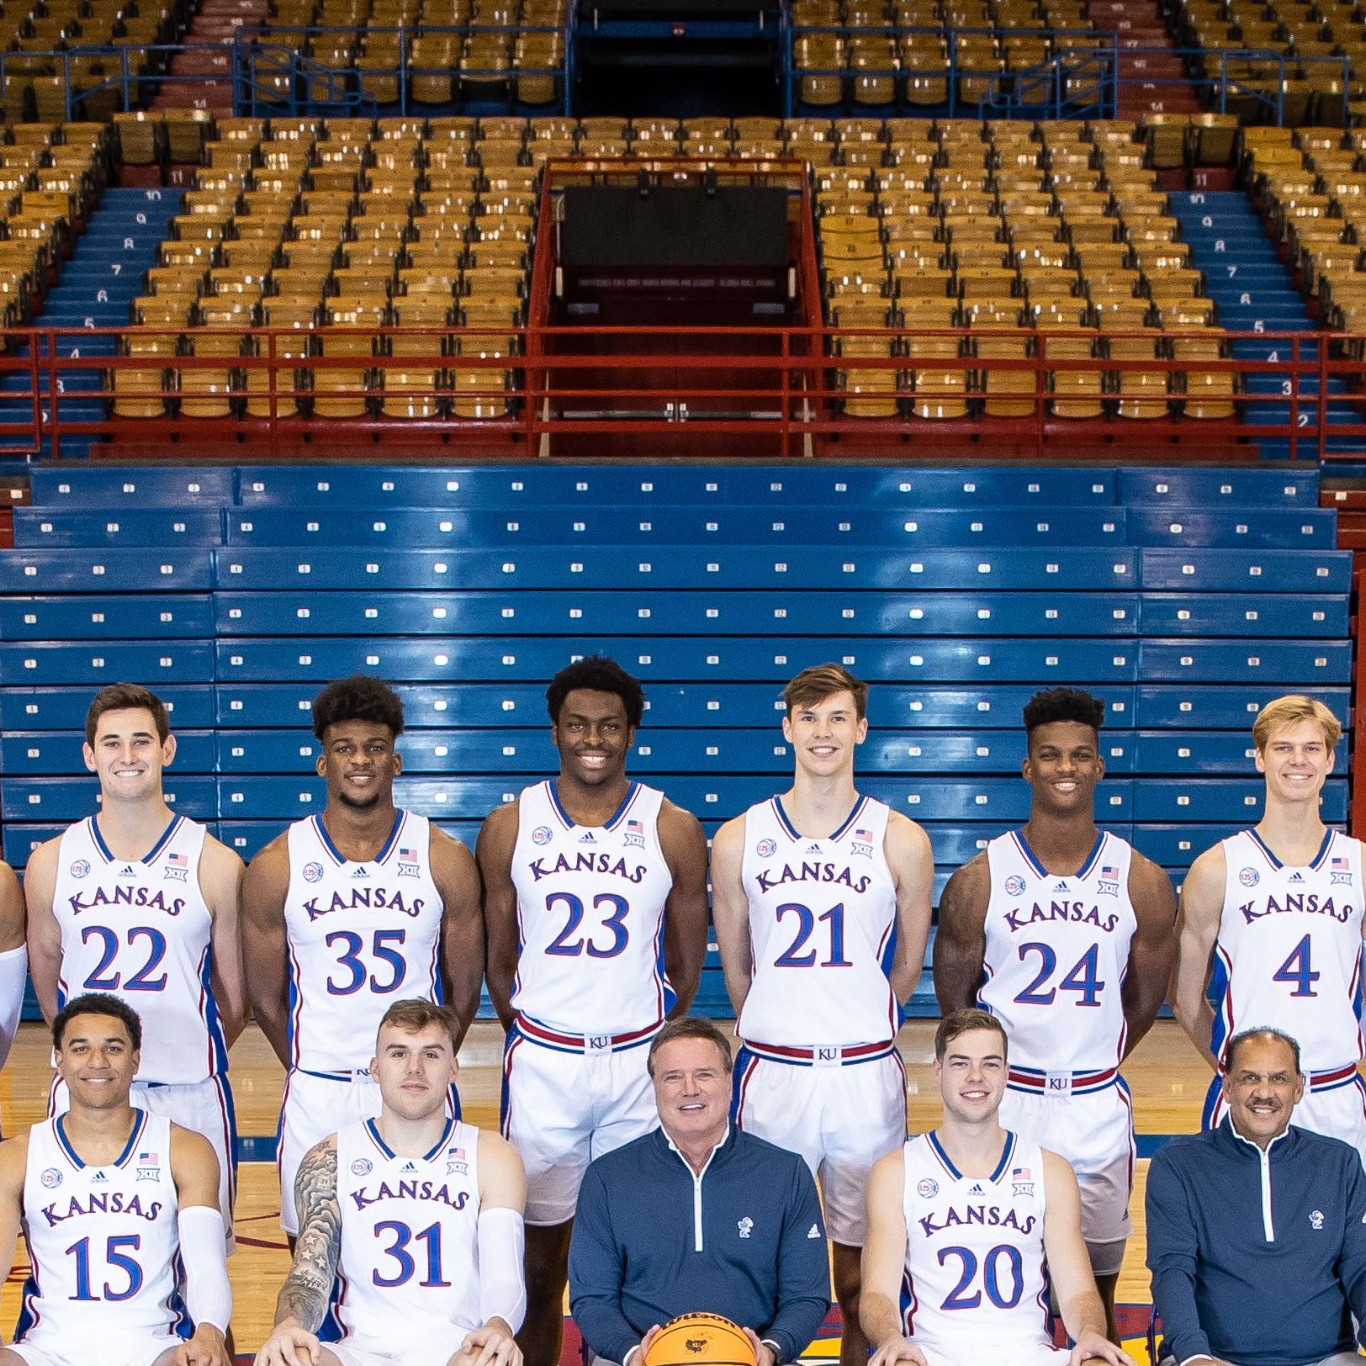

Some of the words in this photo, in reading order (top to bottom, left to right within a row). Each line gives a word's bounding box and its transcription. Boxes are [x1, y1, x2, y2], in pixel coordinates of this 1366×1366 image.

[171, 171, 183, 183] 11
[1196, 174, 1207, 186] 11
[146, 190, 162, 201] 10
[111, 264, 122, 276] 7
[1227, 266, 1237, 278] 7
[1254, 320, 1264, 333] 5
[1267, 351, 1279, 363] 4
[1282, 380, 1292, 395] 3
[1298, 414, 1308, 427] 2
[528, 852, 647, 884] KANSAS
[755, 861, 871, 894] KANSAS
[68, 885, 185, 916] KANSAS
[302, 888, 424, 922] KANSAS
[1239, 893, 1353, 924] KANSAS
[544, 891, 630, 959] 23
[1003, 900, 1119, 933] KANSAS
[773, 902, 853, 968] 21
[81, 925, 168, 991] 22
[325, 929, 407, 996] 35
[1272, 933, 1320, 997] 4
[1013, 942, 1105, 1007] 24
[590, 1037, 608, 1050] KU
[818, 1048, 837, 1061] KU
[1049, 1077, 1068, 1090] KU
[41, 1192, 162, 1227] KANSAS
[350, 1180, 470, 1211] KANSAS
[918, 1205, 1036, 1238] KANSAS
[65, 1234, 144, 1302] 15
[372, 1221, 452, 1287] 31
[937, 1244, 1024, 1311] 20
